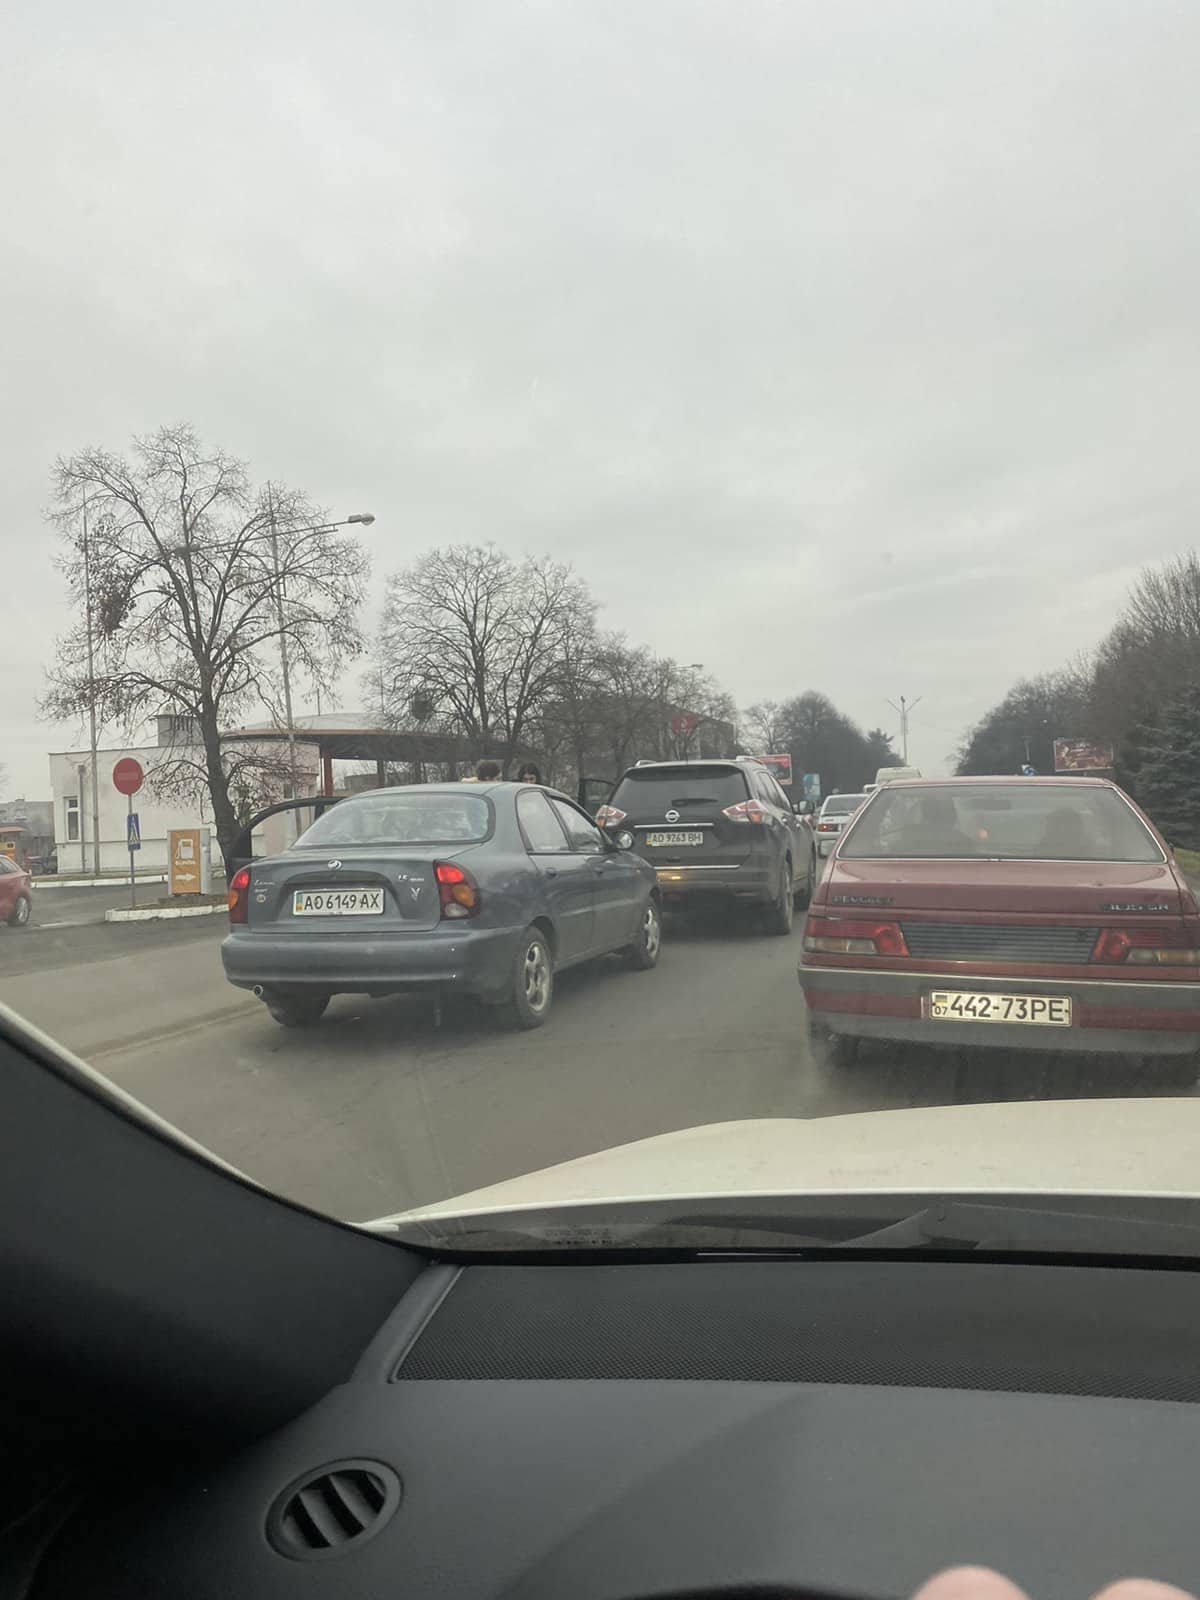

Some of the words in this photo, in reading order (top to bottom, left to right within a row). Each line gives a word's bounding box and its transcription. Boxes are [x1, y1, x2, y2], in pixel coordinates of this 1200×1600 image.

[304, 895, 323, 910] AO
[326, 894, 357, 909] 6149
[359, 893, 379, 908] AX
[934, 1005, 948, 1016] 07
[950, 994, 1064, 1022] 442-73PE
